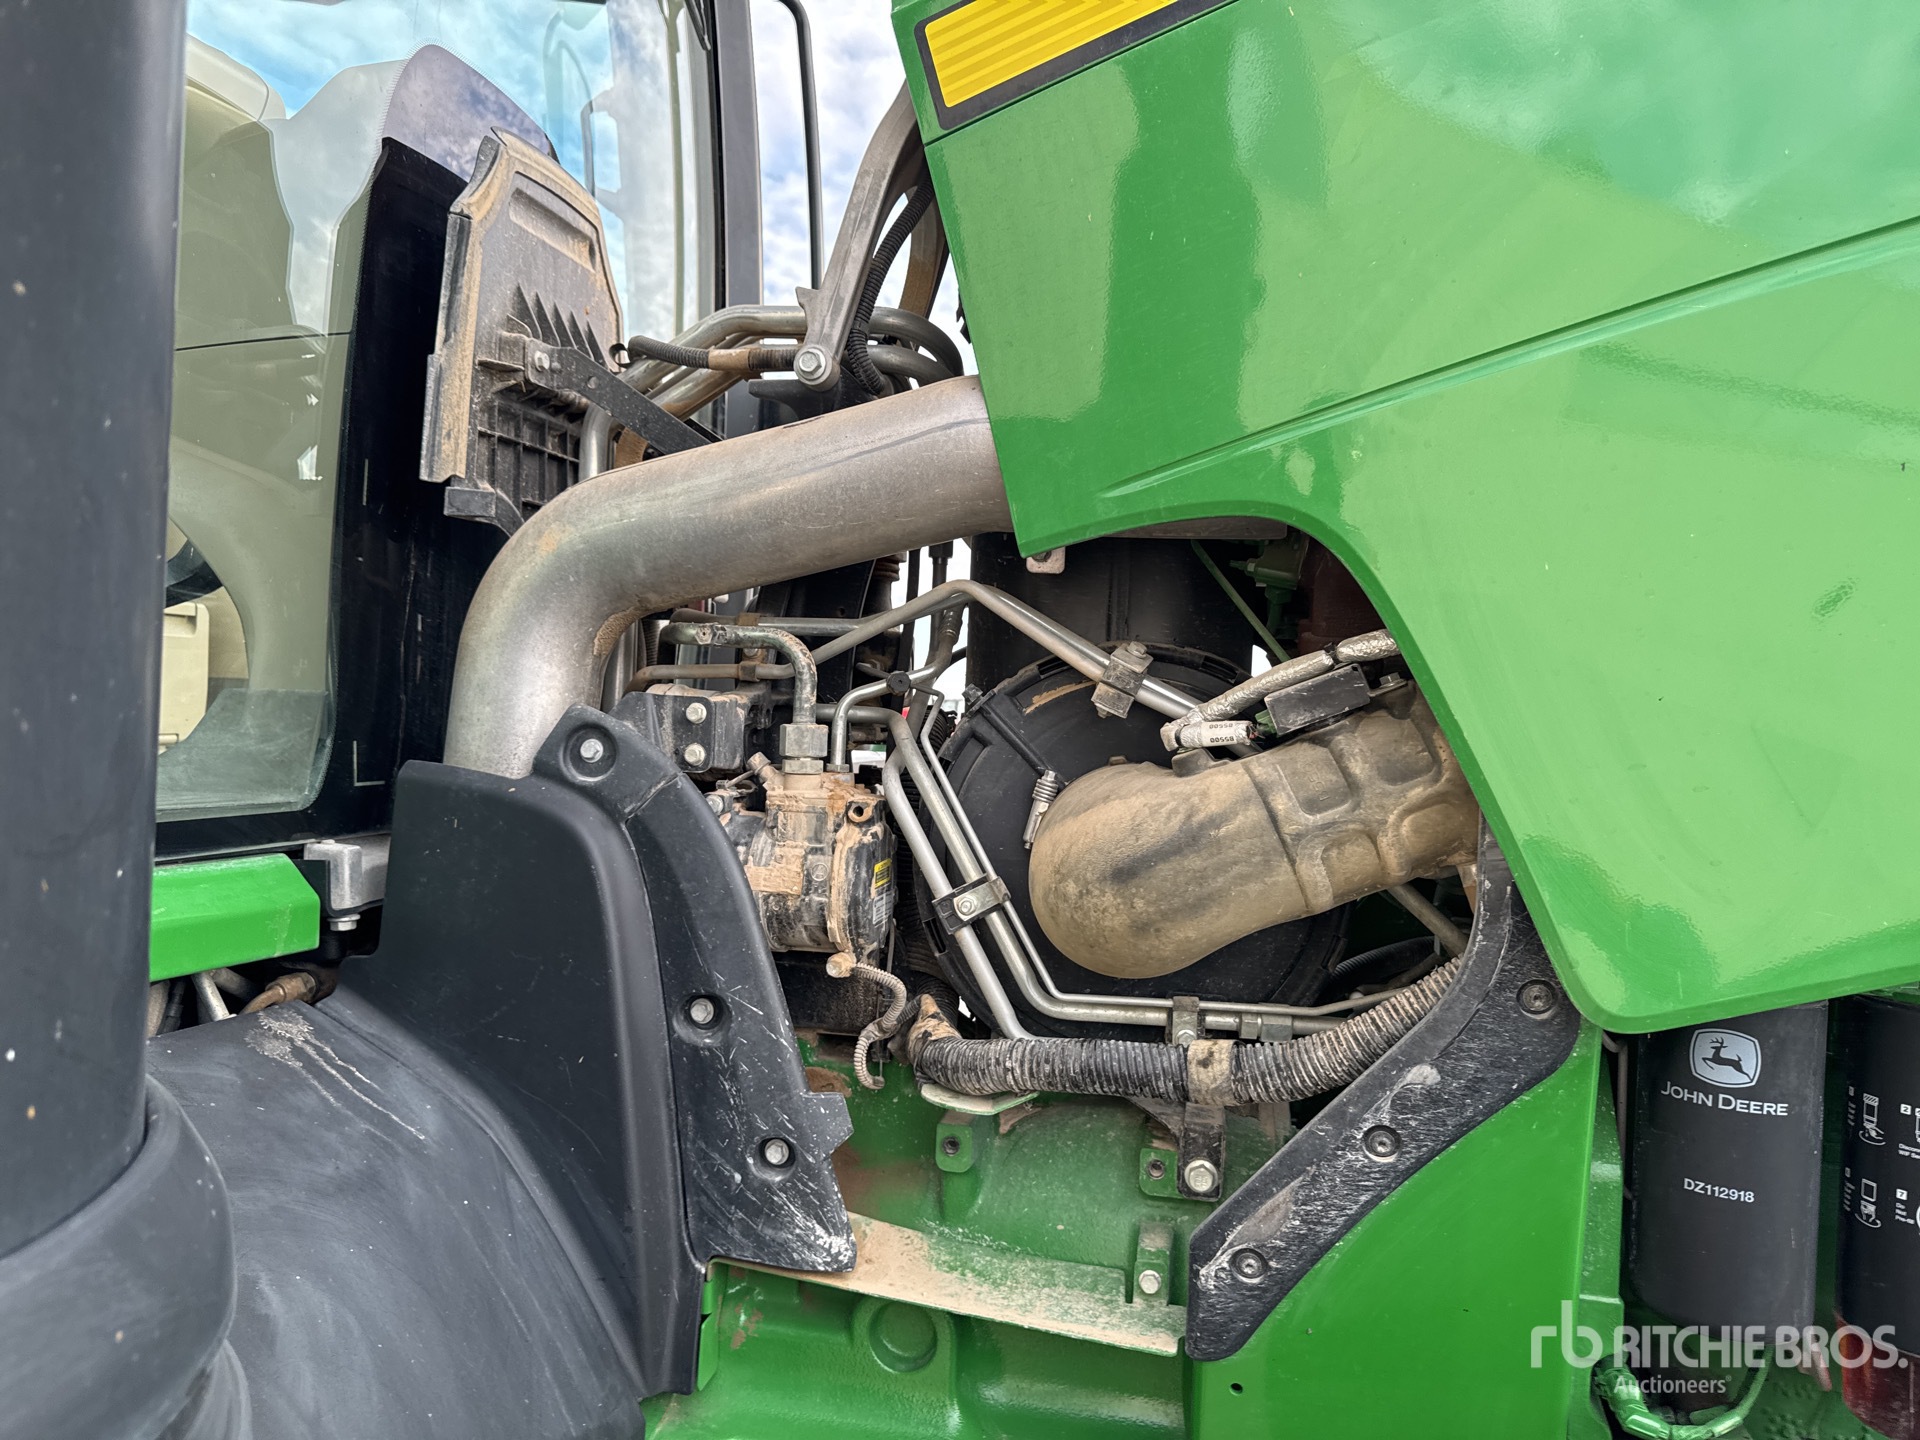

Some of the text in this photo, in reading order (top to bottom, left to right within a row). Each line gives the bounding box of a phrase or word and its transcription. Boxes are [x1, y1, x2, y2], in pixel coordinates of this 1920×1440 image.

[1661, 1081, 1789, 1116] JOHN DEERE
[1684, 1178, 1755, 1203] DZ112918
